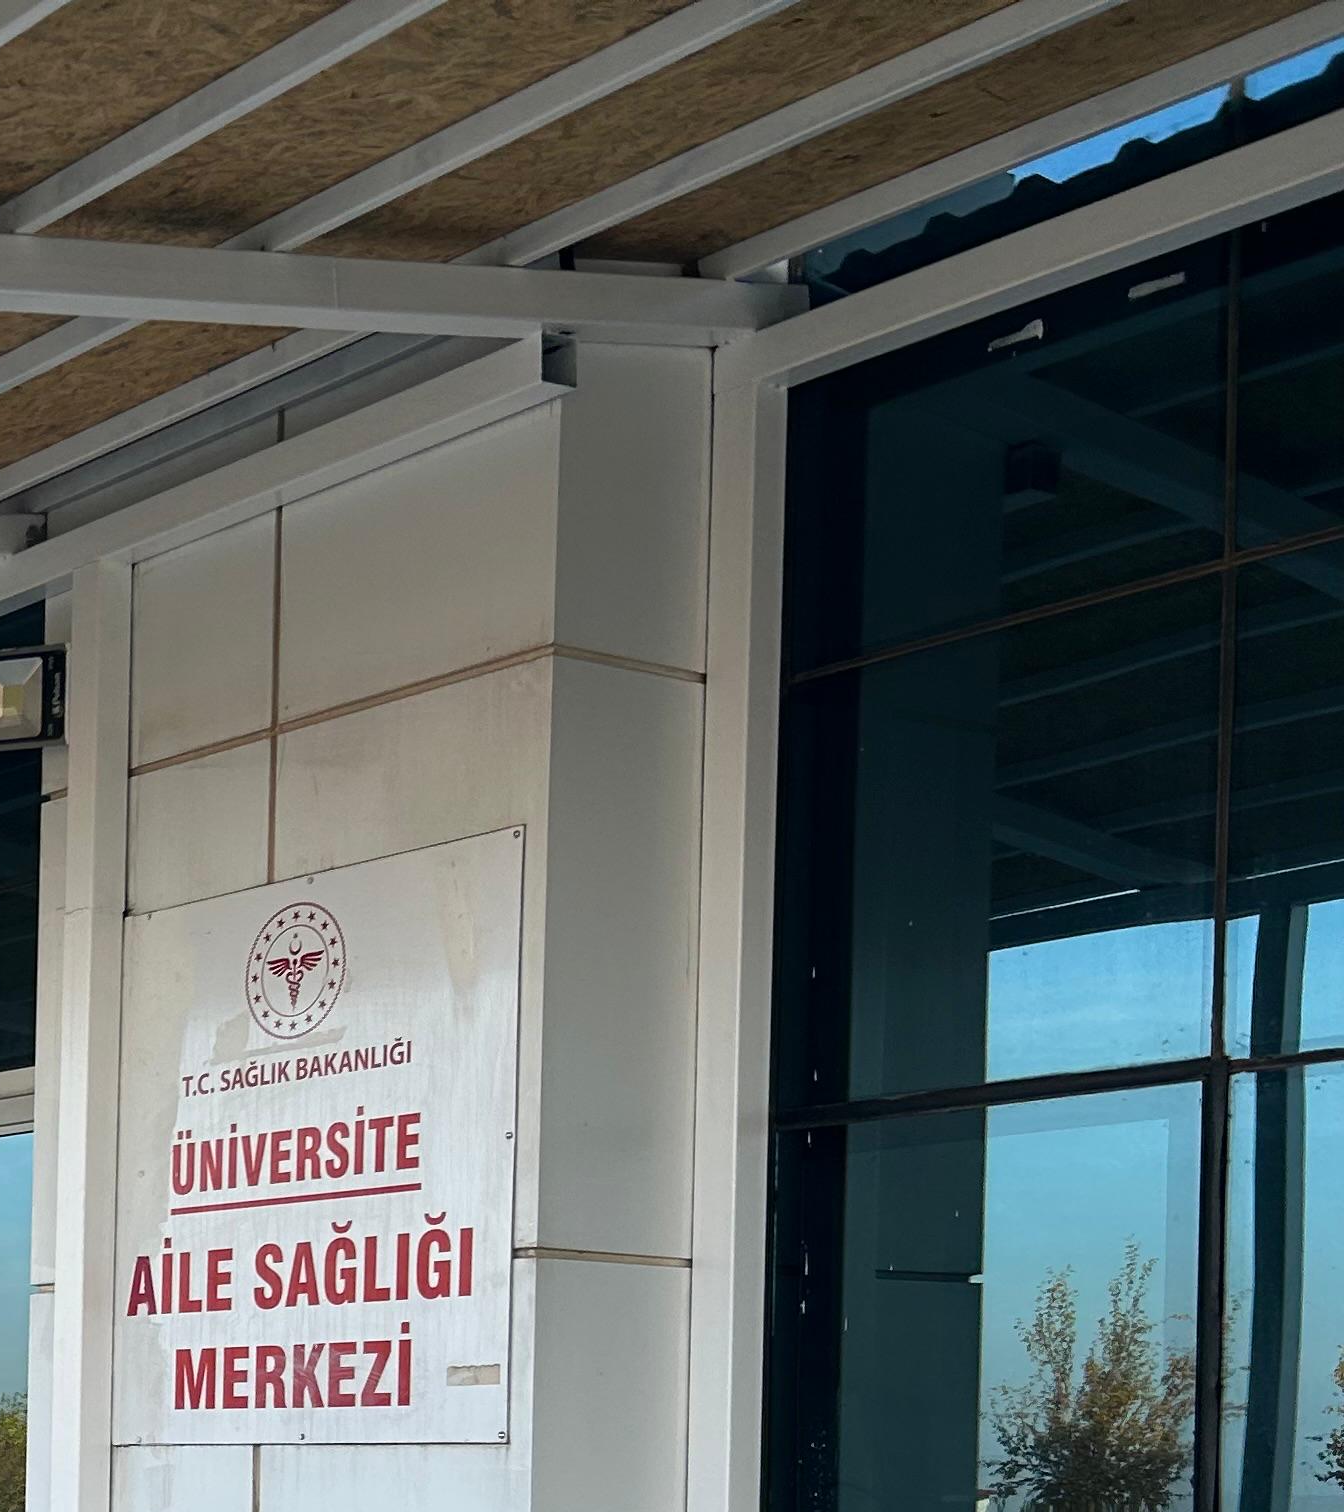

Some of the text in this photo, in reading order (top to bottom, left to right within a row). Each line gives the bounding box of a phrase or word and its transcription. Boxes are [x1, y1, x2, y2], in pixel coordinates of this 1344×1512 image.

[182, 1036, 413, 1098] T.C. SAĞLIK BAKANLIĞI
[171, 1106, 421, 1196] ÜNİVERSİTE
[126, 1210, 475, 1318] AİLE SAĞLIĞI
[173, 1321, 413, 1411] MERKEZİ
